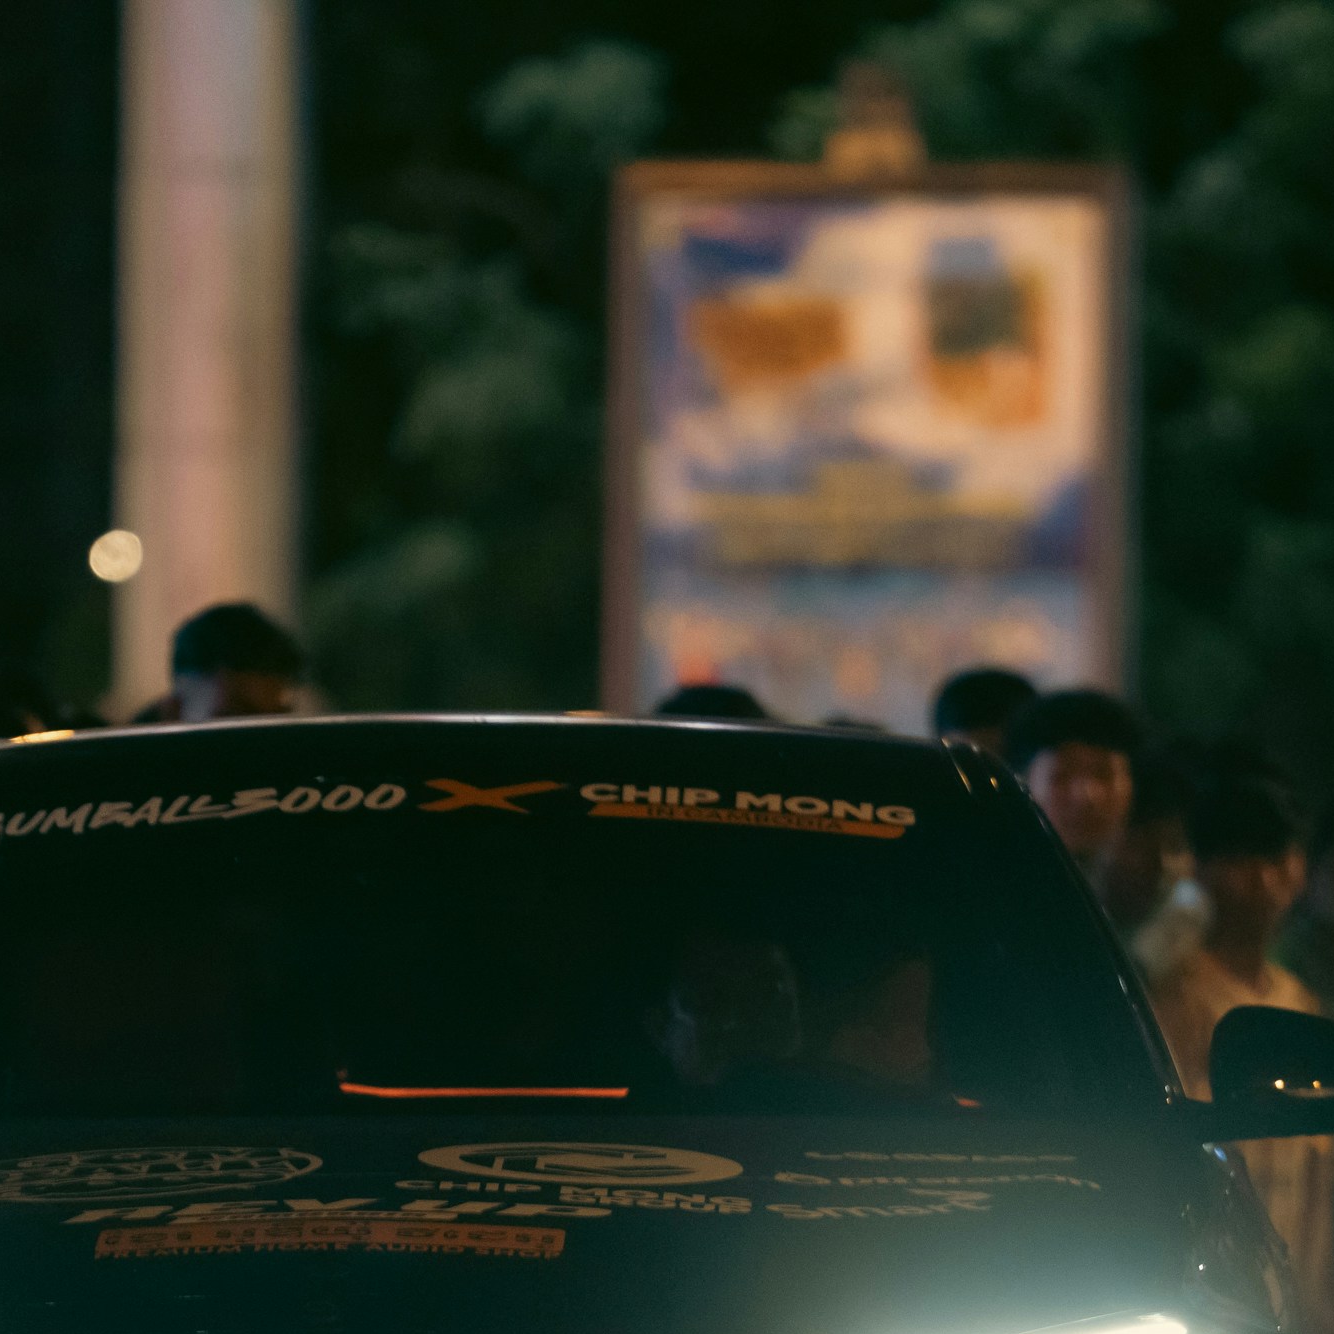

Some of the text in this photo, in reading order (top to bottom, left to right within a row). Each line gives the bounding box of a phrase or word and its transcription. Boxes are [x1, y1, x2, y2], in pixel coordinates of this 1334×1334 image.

[579, 783, 916, 826] CHIP MONG
[395, 1180, 752, 1206] CHIP MONG
[400, 1199, 611, 1217] UP
[366, 1242, 466, 1255] AUDIO
[475, 1245, 562, 1261] SHOP
